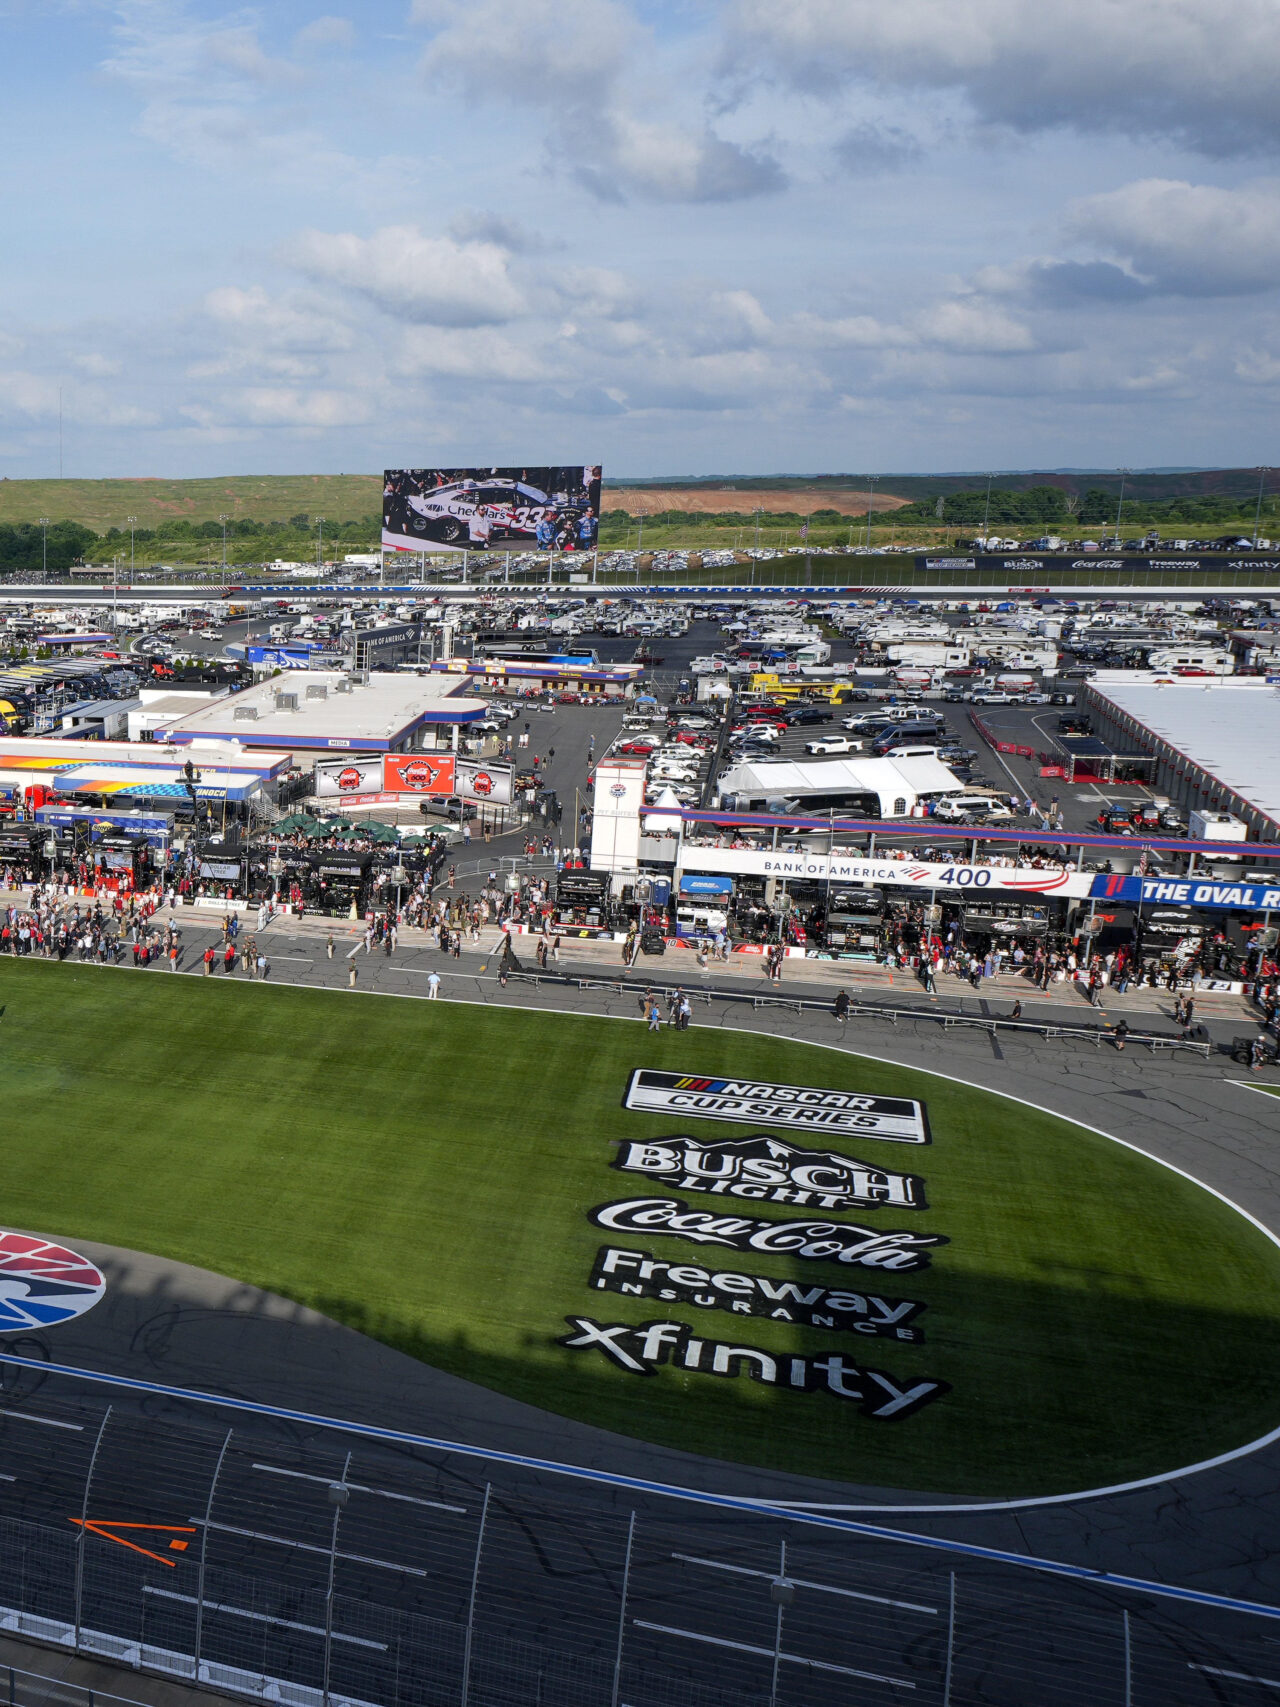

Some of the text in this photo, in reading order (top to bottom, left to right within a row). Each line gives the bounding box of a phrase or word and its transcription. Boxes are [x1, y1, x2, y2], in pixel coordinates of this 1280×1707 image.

[448, 505, 505, 520] Chear's
[510, 506, 545, 528] 33
[1003, 560, 1043, 568] BUSCH
[1072, 560, 1124, 569] Coca-Cola
[1149, 560, 1199, 568] Freeway
[1228, 560, 1280, 569] xfinity
[385, 633, 406, 643] AMERICA
[197, 789, 227, 797] UNOCO
[764, 861, 896, 879] BANK OF AMERICA
[938, 867, 992, 887] 400
[1143, 881, 1192, 901] THE
[1193, 885, 1257, 906] OVAL
[721, 1081, 877, 1111] NASCAR
[667, 1094, 882, 1129] CUP SERIES
[621, 1142, 917, 1207] BUSCH
[679, 1174, 848, 1209] LIGHT
[596, 1199, 940, 1270] Coca-Cola
[602, 1248, 916, 1325] Freeway
[597, 1277, 915, 1341] INSURANCE
[566, 1318, 939, 1417] xfinity
